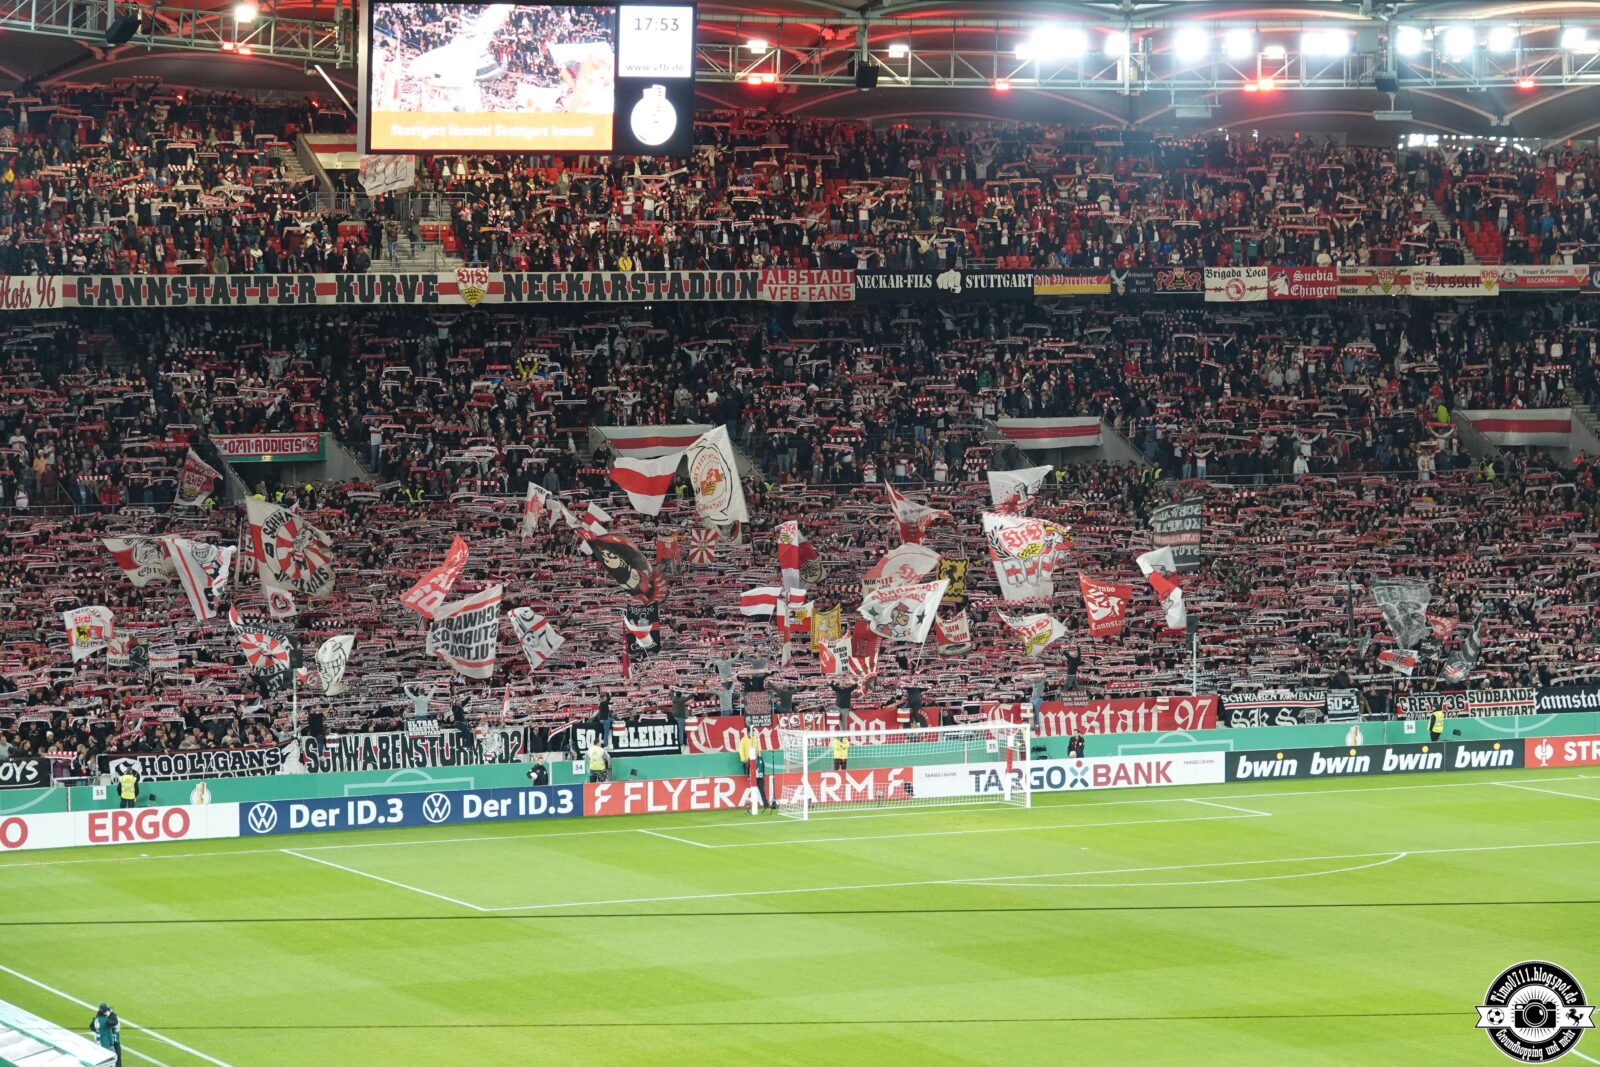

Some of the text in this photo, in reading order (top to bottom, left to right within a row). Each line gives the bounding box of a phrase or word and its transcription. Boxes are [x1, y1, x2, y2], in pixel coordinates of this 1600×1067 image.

[634, 17, 679, 31] 17:53
[503, 271, 758, 302] NECKARSTADION
[766, 269, 855, 285] ALBSTADT
[857, 274, 1034, 289] NECKAR-FILS STUTTGART
[1052, 274, 1098, 286] Warriors
[1293, 270, 1334, 282] Suebia
[77, 274, 438, 306] CANNSTATTER KURVE
[768, 286, 851, 300] VFB-FANS
[1221, 692, 1277, 703] SCHWABEN
[1327, 696, 1359, 710] 50+1
[1399, 695, 1465, 712] CREW 36
[1174, 699, 1212, 731] 97
[1470, 704, 1535, 717] STUTTGART
[618, 724, 679, 748] BLEIBT!
[139, 748, 281, 775] HOOLIGANS
[1235, 752, 1298, 779] bwin
[1310, 748, 1371, 775] bwin
[1382, 745, 1443, 771] bwin
[1455, 742, 1514, 769] bwin
[289, 798, 404, 829] Der ID.3
[462, 789, 573, 819] Der ID.3
[88, 807, 190, 844] ERGO
